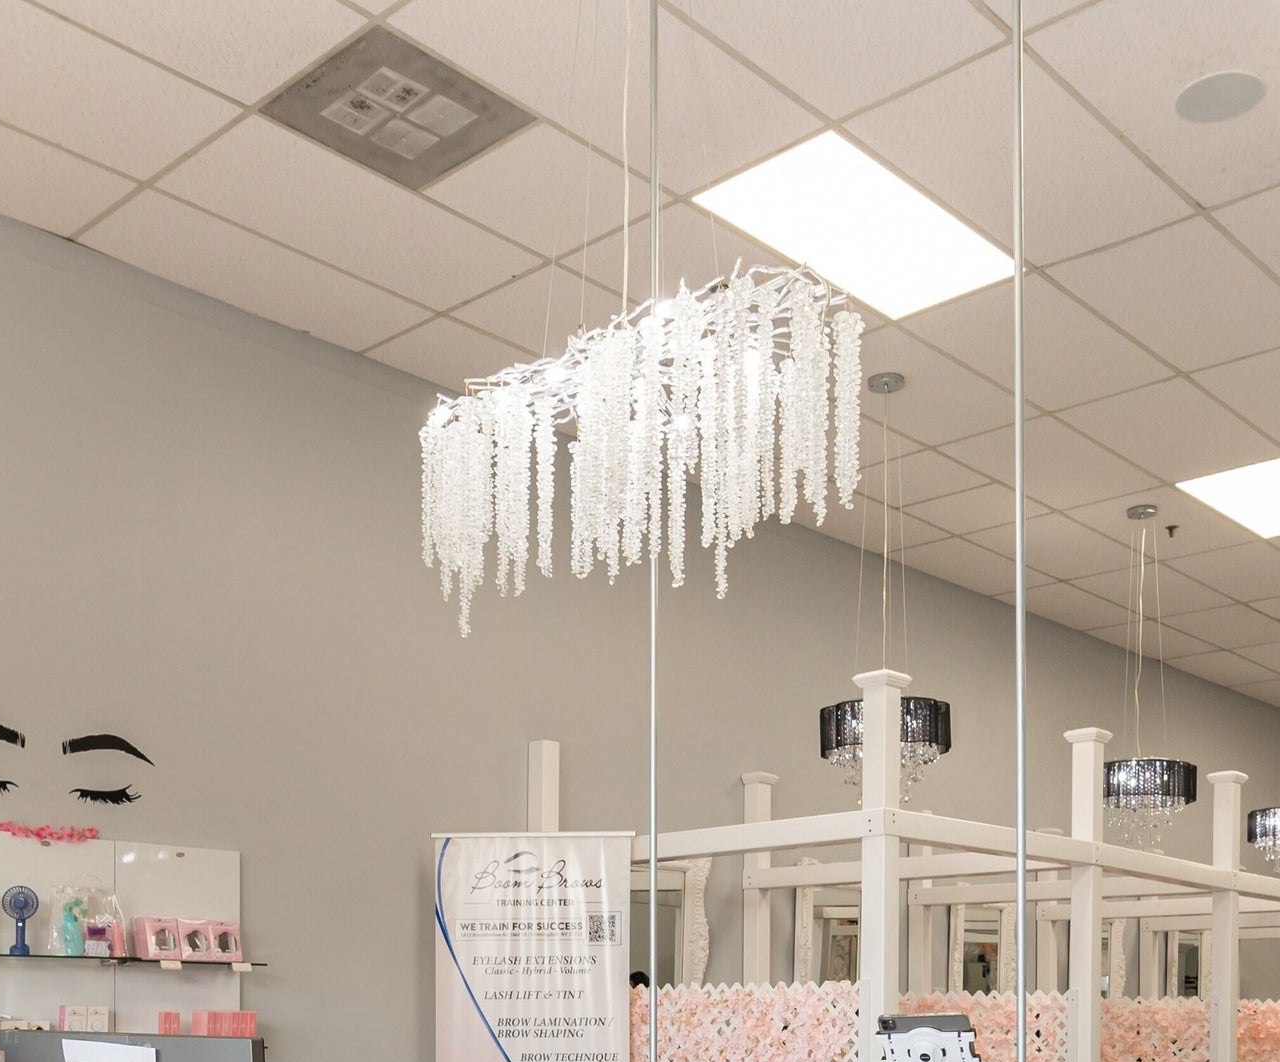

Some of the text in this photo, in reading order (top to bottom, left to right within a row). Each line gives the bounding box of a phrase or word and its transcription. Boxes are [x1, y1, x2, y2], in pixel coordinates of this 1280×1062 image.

[469, 859, 604, 895] Boom Brows
[496, 899, 574, 907] TRAINING CENTER
[460, 922, 583, 931] WE TRAIN FOR SUCCESS
[472, 955, 597, 966] EYELASH EXTENSIONS
[484, 966, 592, 976] Classic Hybrid Volume
[484, 990, 584, 1000] LASH LIFT & TINT
[497, 1018, 532, 1027] BROW
[533, 1017, 607, 1027] LAMINATION
[497, 1029, 584, 1039] BROW SHAPING
[520, 1052, 619, 1062] BROW TECHNIQUE
